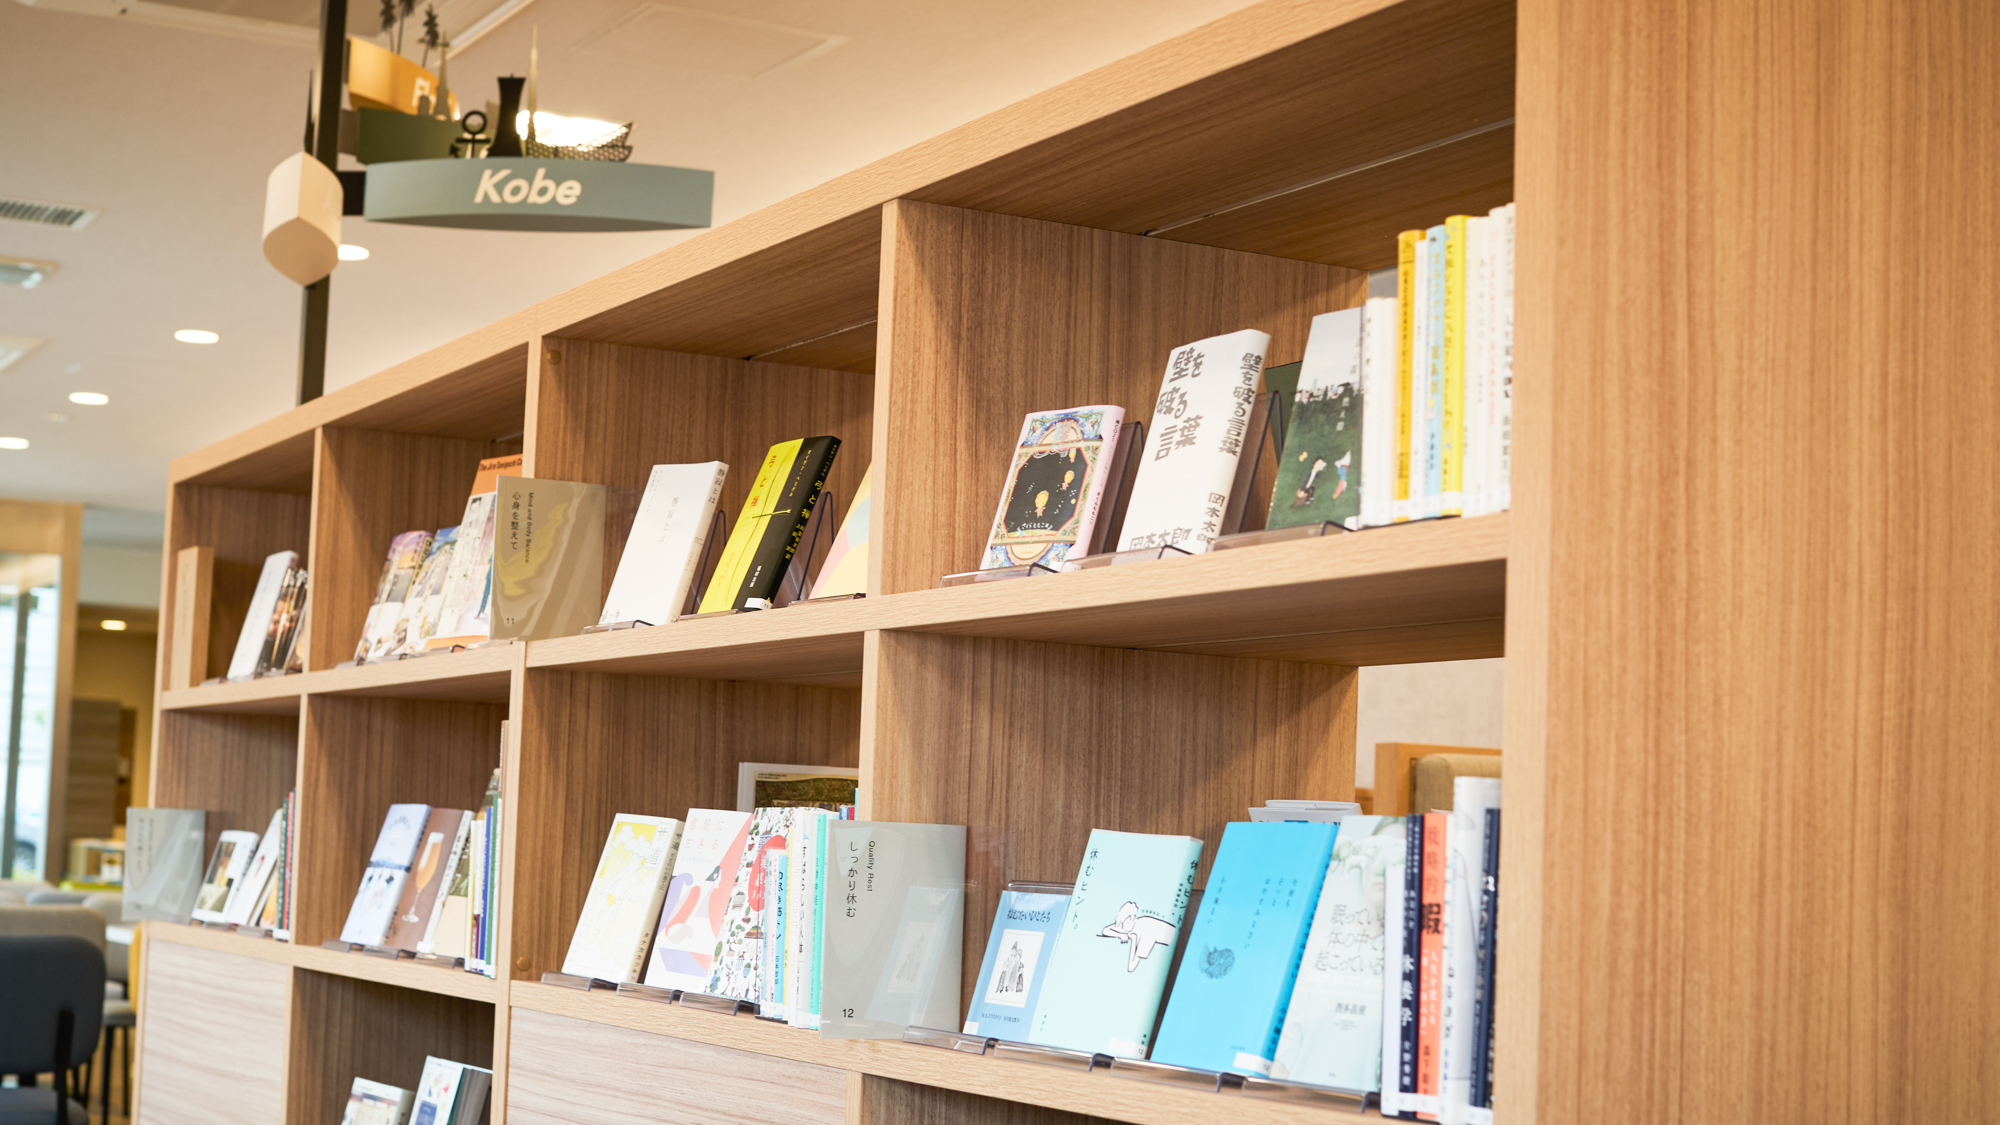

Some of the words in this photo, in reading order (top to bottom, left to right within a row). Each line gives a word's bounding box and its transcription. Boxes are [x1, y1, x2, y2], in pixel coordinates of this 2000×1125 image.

[473, 167, 583, 206] Kobe
[1168, 346, 1205, 384] 壁を
[1156, 386, 1189, 420] 破る
[1218, 352, 1264, 458] 壁を破る言葉
[1153, 414, 1204, 463] 言葉
[708, 468, 726, 504] 静寂とは
[801, 479, 824, 520] 弓と禅
[510, 491, 522, 550] 心身を整えて
[525, 522, 533, 537] Body
[524, 539, 532, 564] Balance
[506, 617, 515, 625] 11
[866, 840, 876, 870] Quality
[846, 841, 859, 918] しっかり休む
[866, 873, 875, 892] Rest
[1072, 848, 1099, 931] 休むヒント。
[842, 1008, 855, 1018] 12
